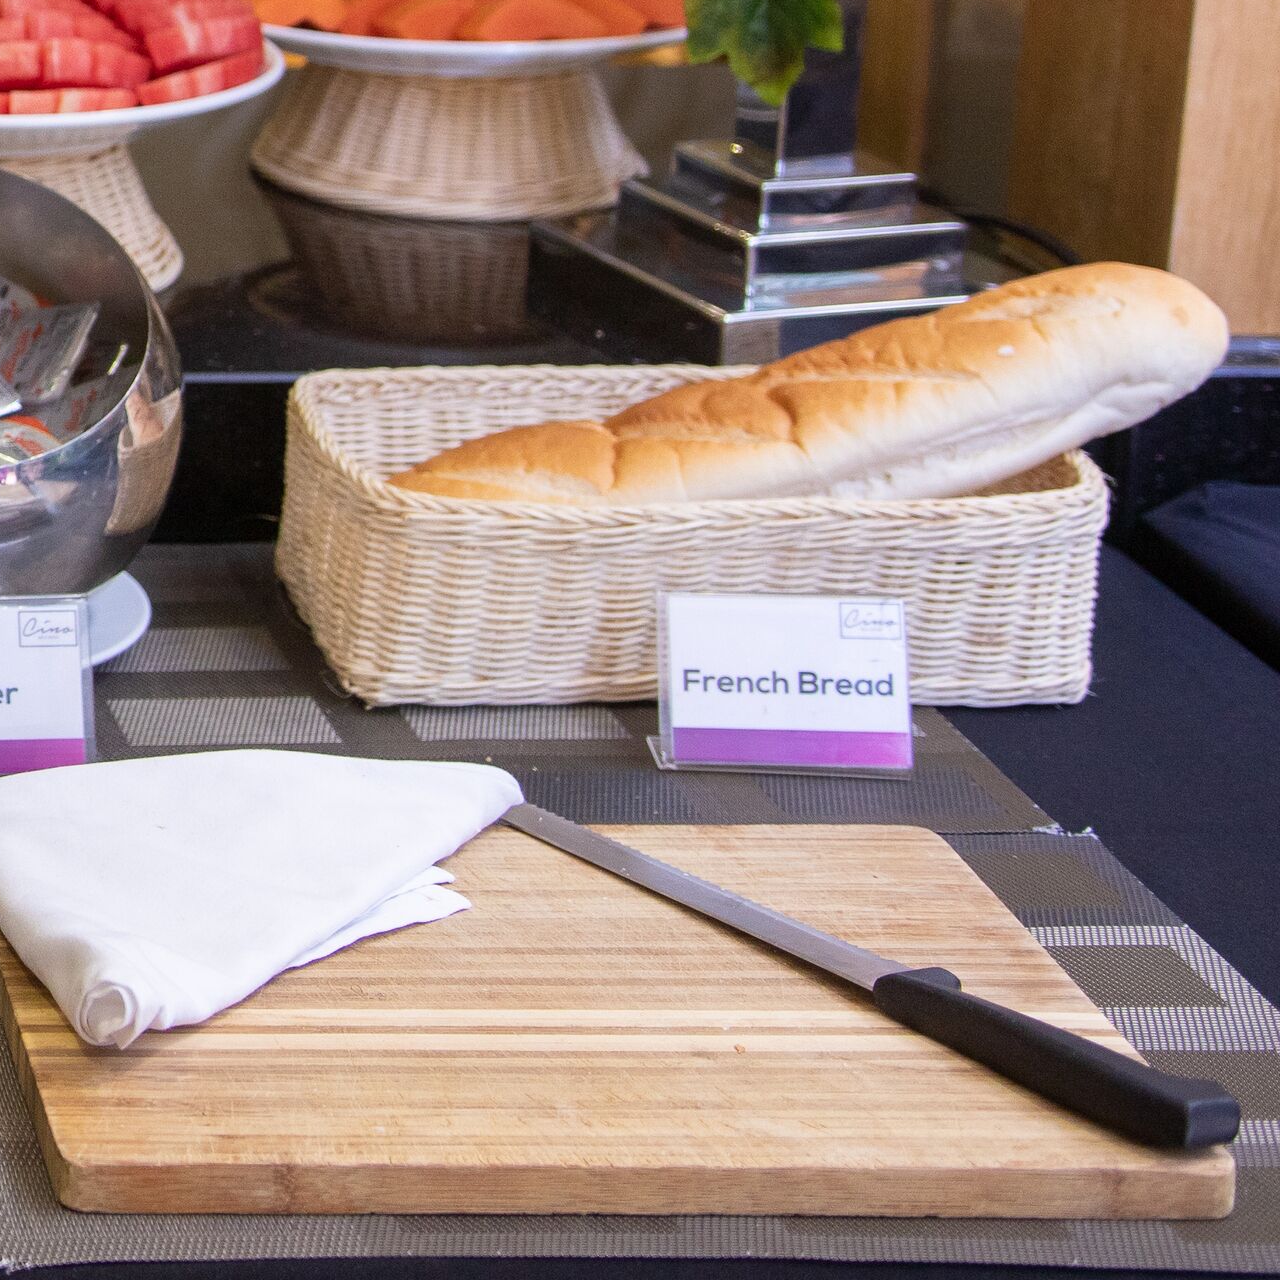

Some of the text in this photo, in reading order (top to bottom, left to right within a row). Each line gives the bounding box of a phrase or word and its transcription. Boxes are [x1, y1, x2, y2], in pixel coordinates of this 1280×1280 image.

[22, 617, 74, 638] Cino
[683, 669, 894, 697] French Bread
